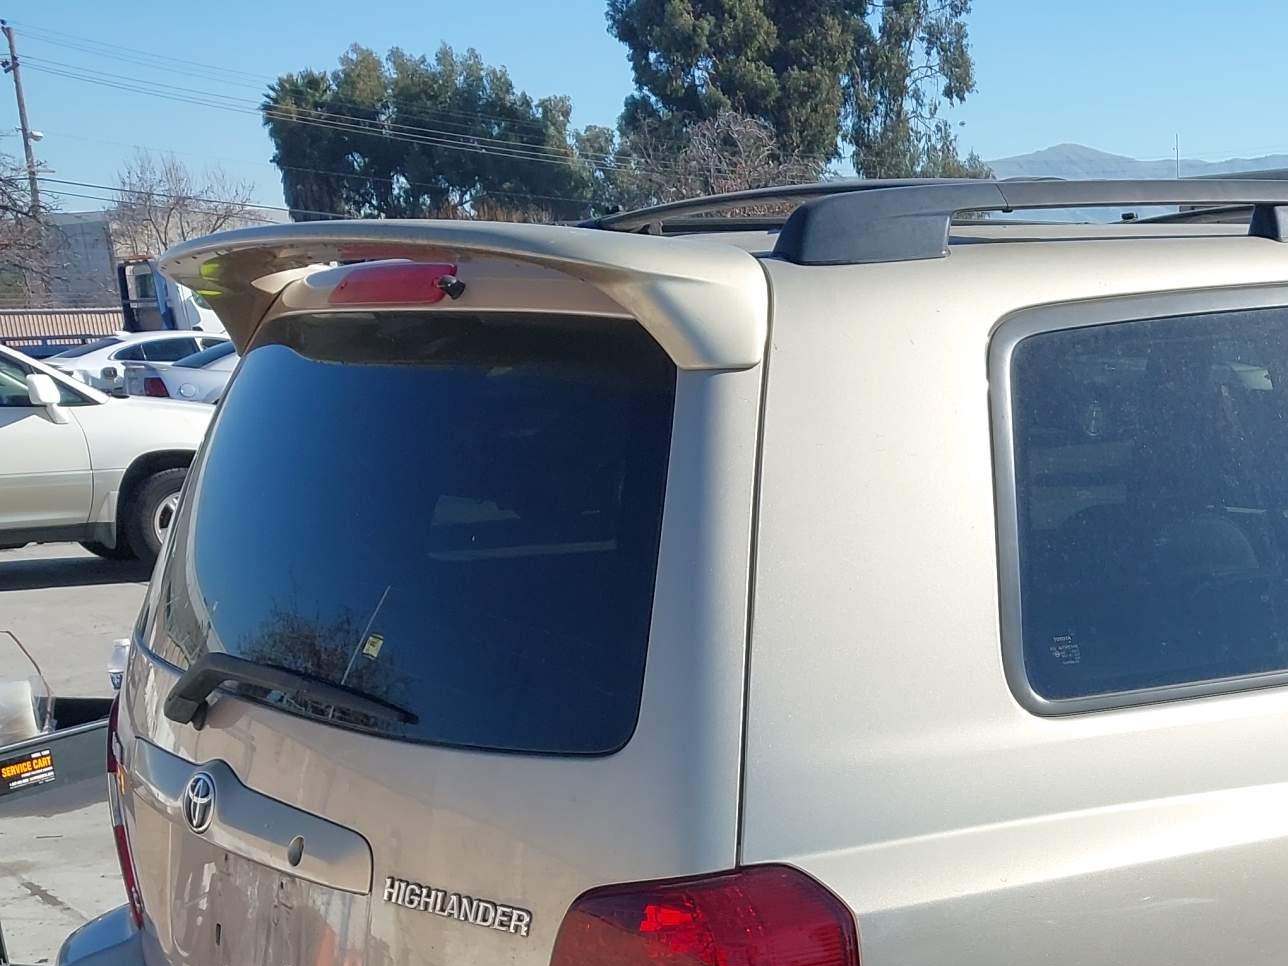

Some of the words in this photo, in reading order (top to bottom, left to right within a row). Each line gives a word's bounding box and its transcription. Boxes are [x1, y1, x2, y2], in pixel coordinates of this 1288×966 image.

[1, 760, 32, 778] SERVICE
[32, 756, 51, 769] CART
[383, 876, 532, 937] HIGHLANDER
